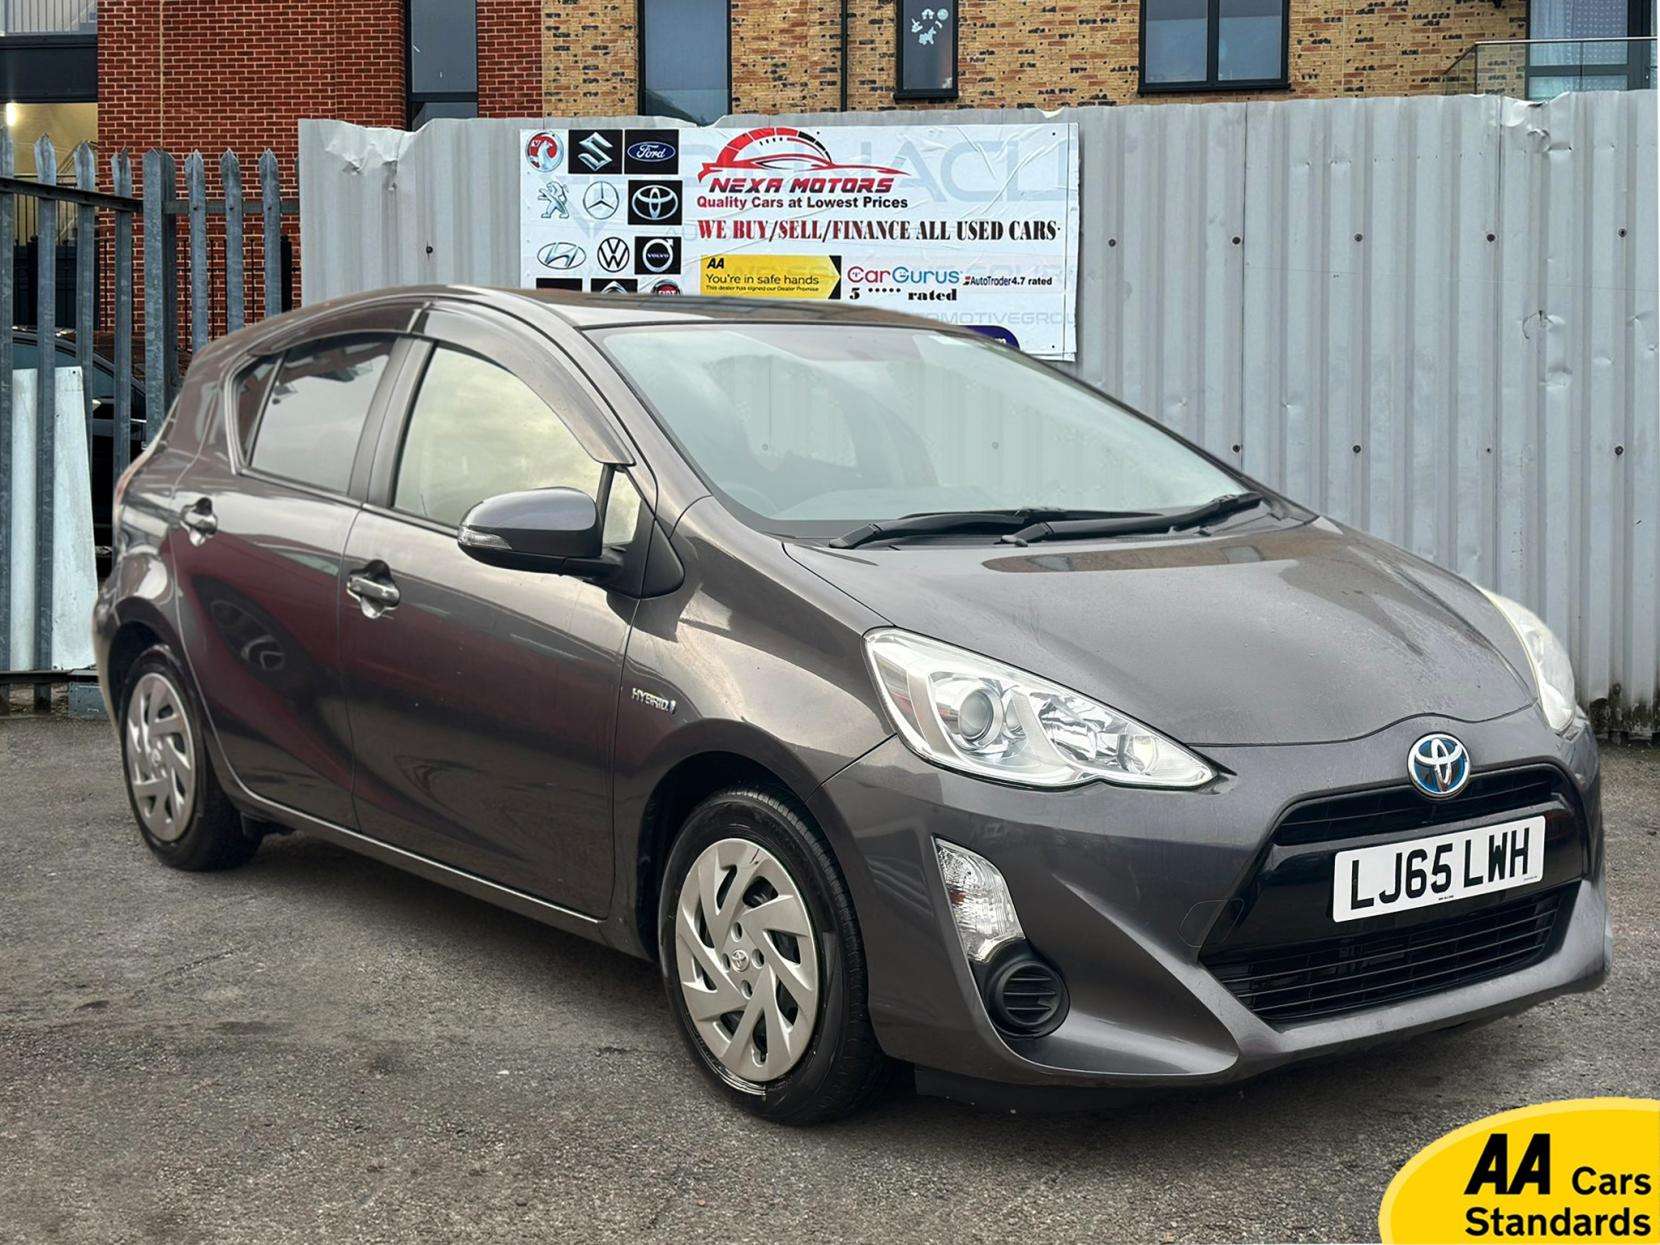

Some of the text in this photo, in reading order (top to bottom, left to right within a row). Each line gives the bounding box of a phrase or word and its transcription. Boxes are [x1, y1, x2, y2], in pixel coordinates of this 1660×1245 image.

[636, 145, 666, 158] Ford
[709, 178, 894, 194] NEXA MOTORS
[697, 196, 908, 210] Quality Cars at Lowest Prices
[697, 220, 726, 239] WE
[916, 220, 951, 240] ALL
[957, 220, 1003, 240] USED
[1009, 220, 1057, 240] CARS
[707, 257, 725, 269] AA
[706, 274, 819, 285] You're in safe hands
[847, 266, 960, 284] CarGurus
[1028, 276, 1052, 285] rated
[850, 288, 957, 301] 5 rated
[632, 687, 669, 712] HYBRID
[1350, 827, 1530, 910] LJ65 LWH
